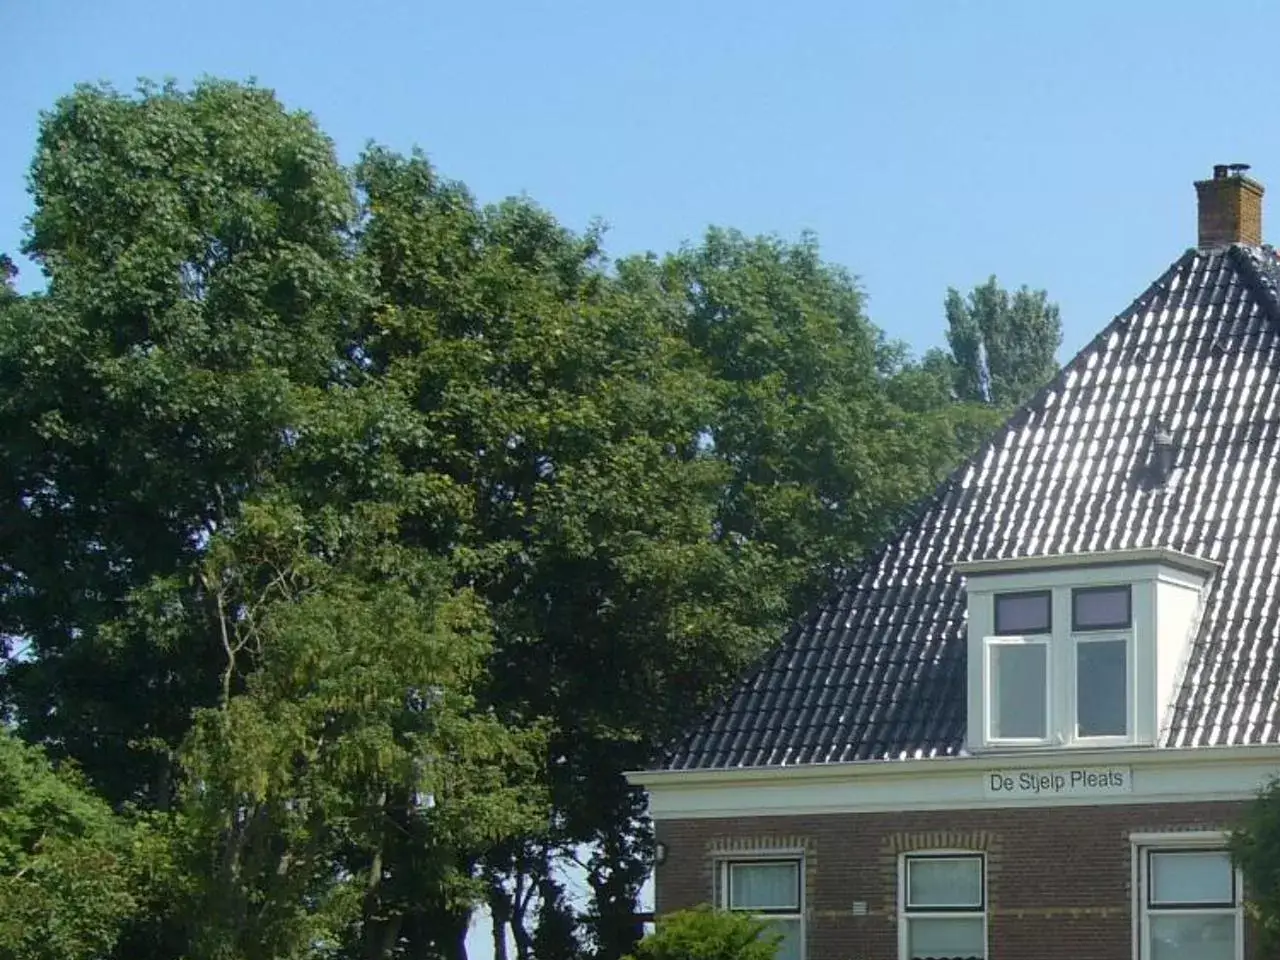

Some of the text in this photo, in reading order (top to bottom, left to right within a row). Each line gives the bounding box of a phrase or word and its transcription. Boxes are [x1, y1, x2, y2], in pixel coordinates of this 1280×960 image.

[990, 769, 1124, 793] De Stjelp Pleats
